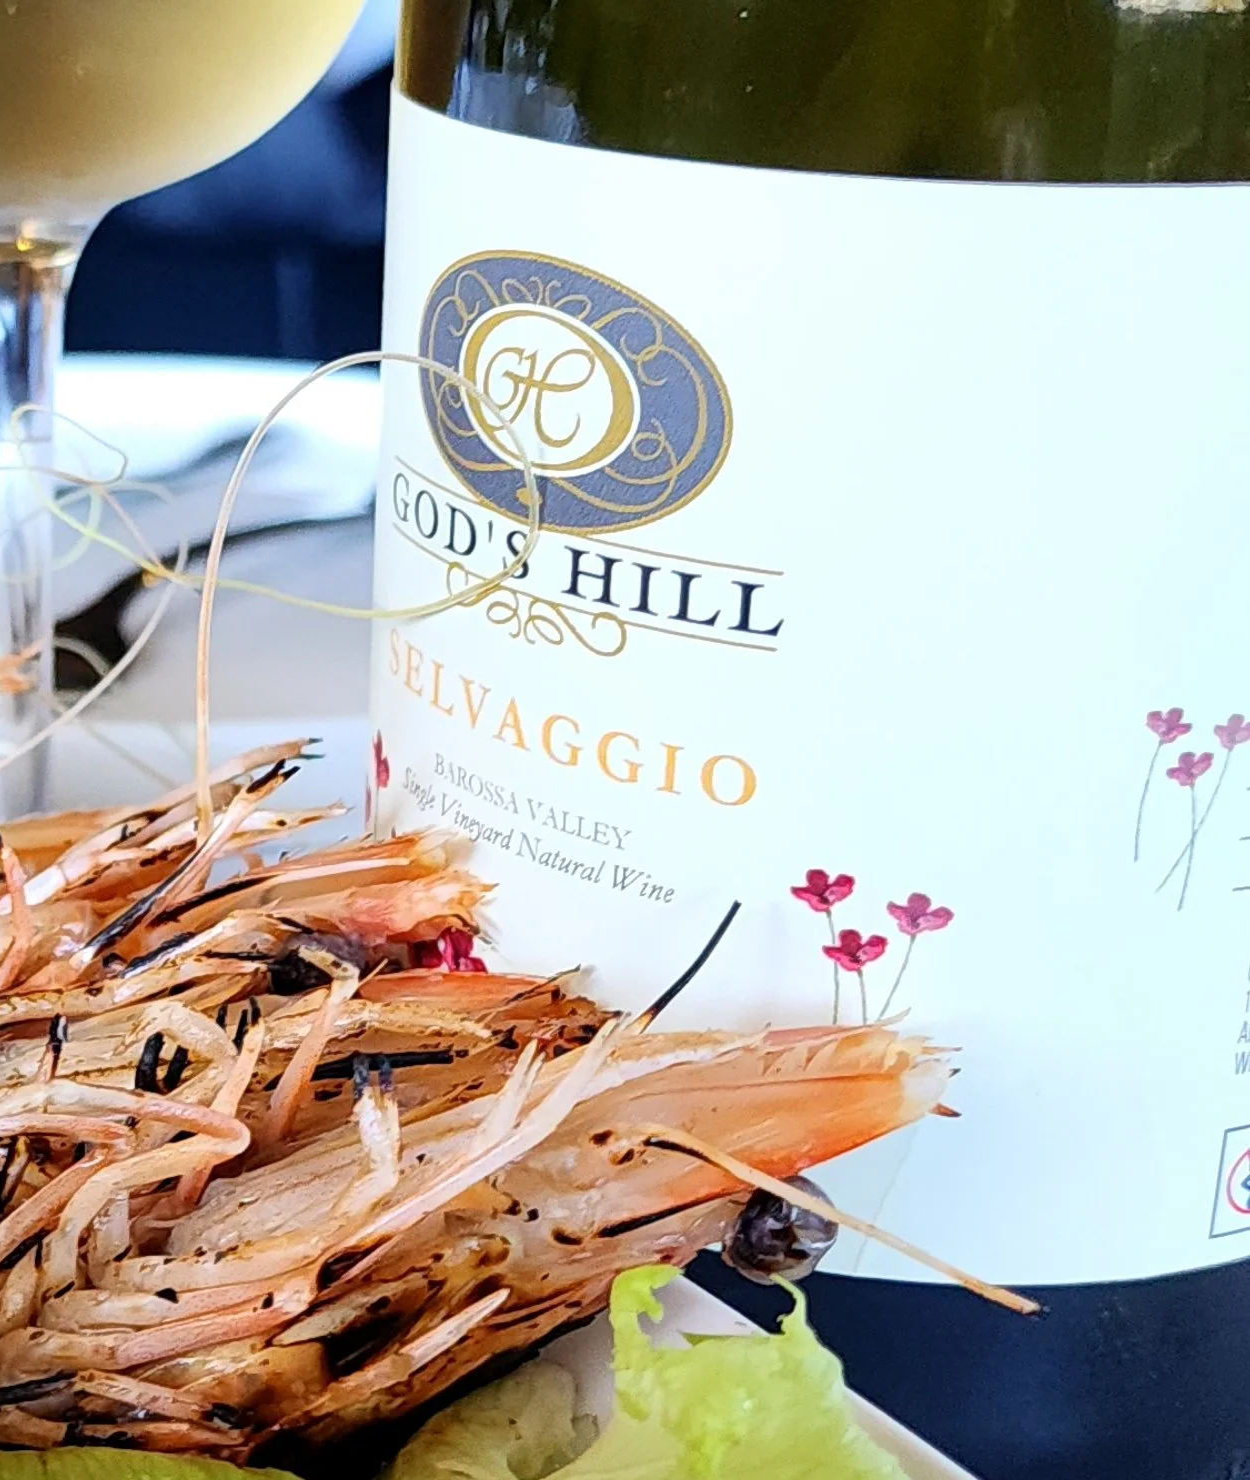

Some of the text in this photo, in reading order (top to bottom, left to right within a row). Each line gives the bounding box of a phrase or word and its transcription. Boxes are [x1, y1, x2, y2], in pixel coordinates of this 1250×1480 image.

[391, 472, 785, 638] GOD'S HILL
[388, 628, 758, 807] SELVAGGIO
[402, 767, 676, 904] Single Vineyard Natural Wine
[434, 752, 632, 851] BAROSSA VALLEY
